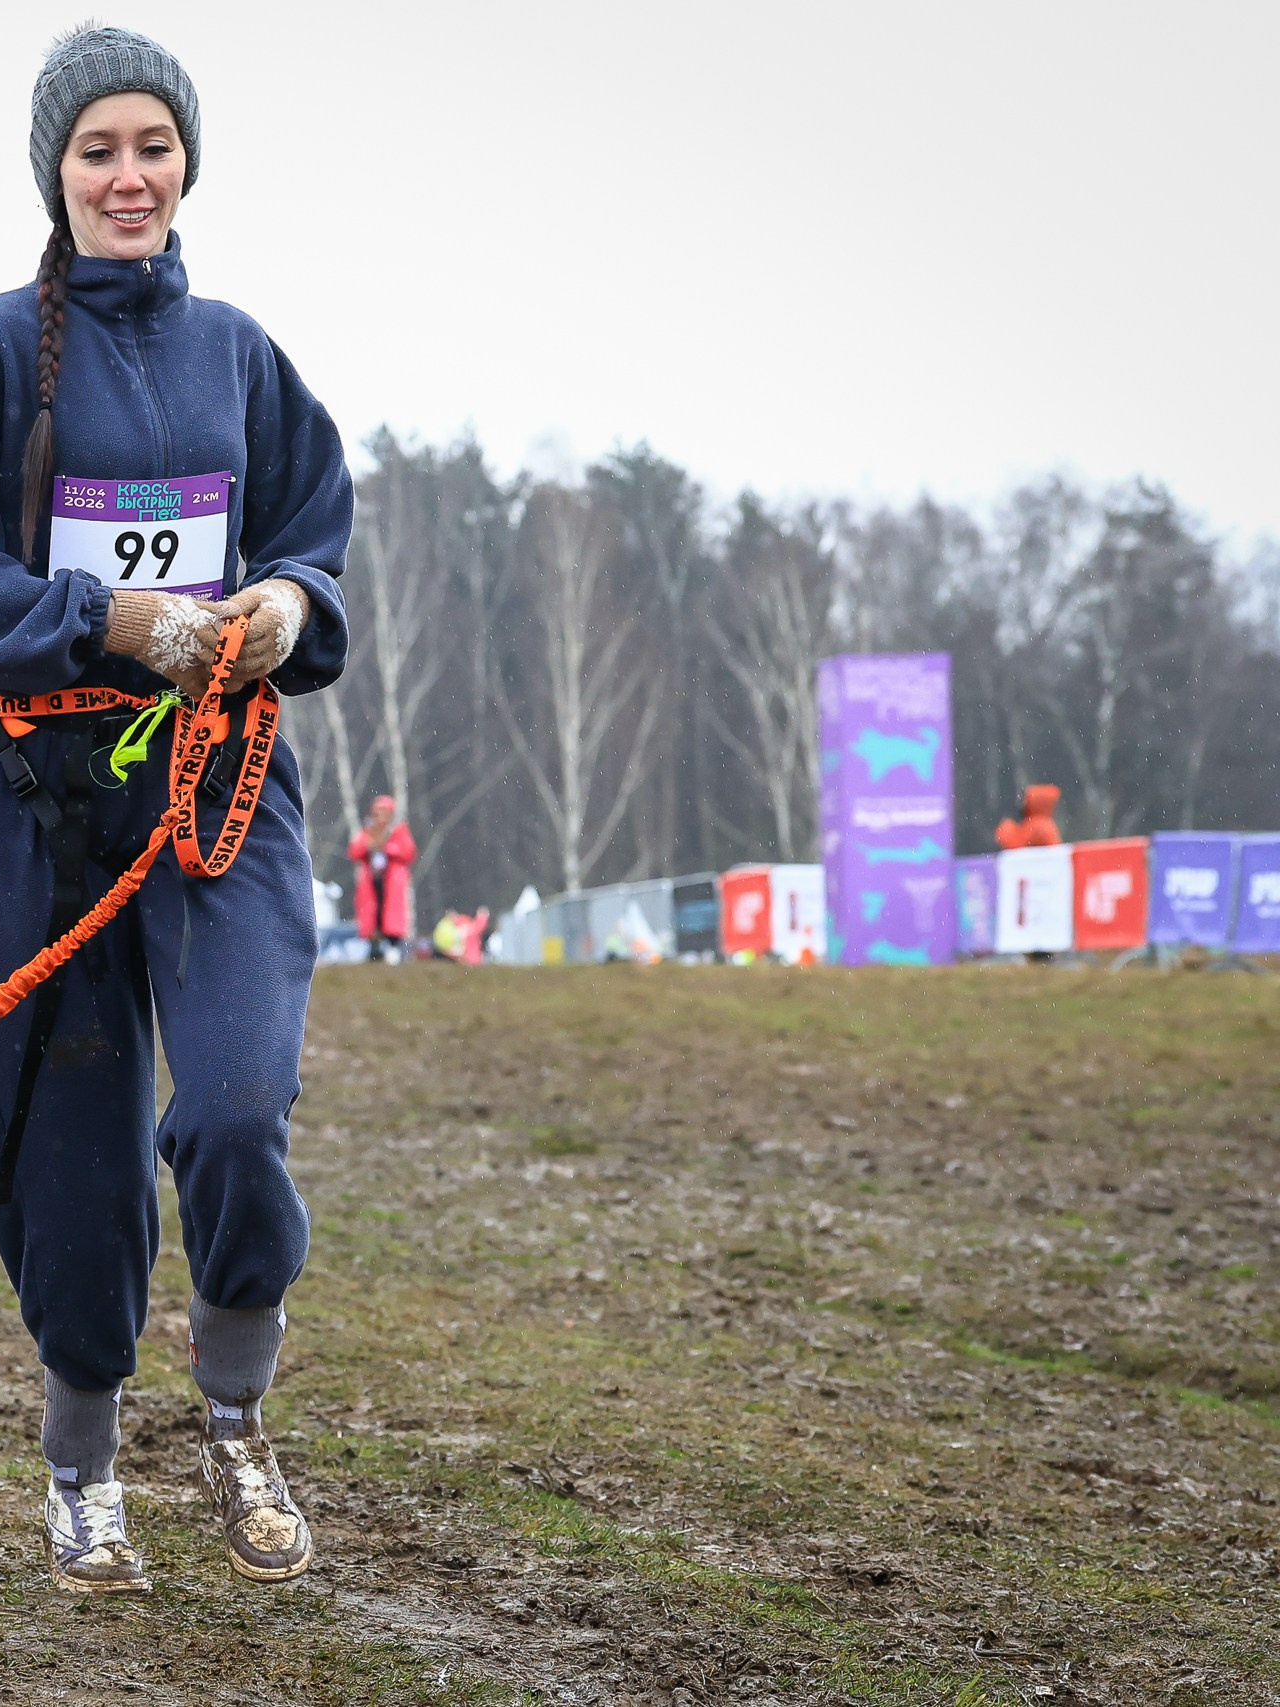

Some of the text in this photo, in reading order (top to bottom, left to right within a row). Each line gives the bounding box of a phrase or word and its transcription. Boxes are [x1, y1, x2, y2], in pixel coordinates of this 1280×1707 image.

[64, 486, 106, 497] 11/04
[117, 483, 170, 496] КРОСС
[64, 496, 105, 509] 2026
[116, 490, 182, 509] БЫСТРЫЙ
[192, 492, 219, 504] 2 КМ
[114, 529, 179, 581] 99
[234, 709, 276, 812] EXTREME
